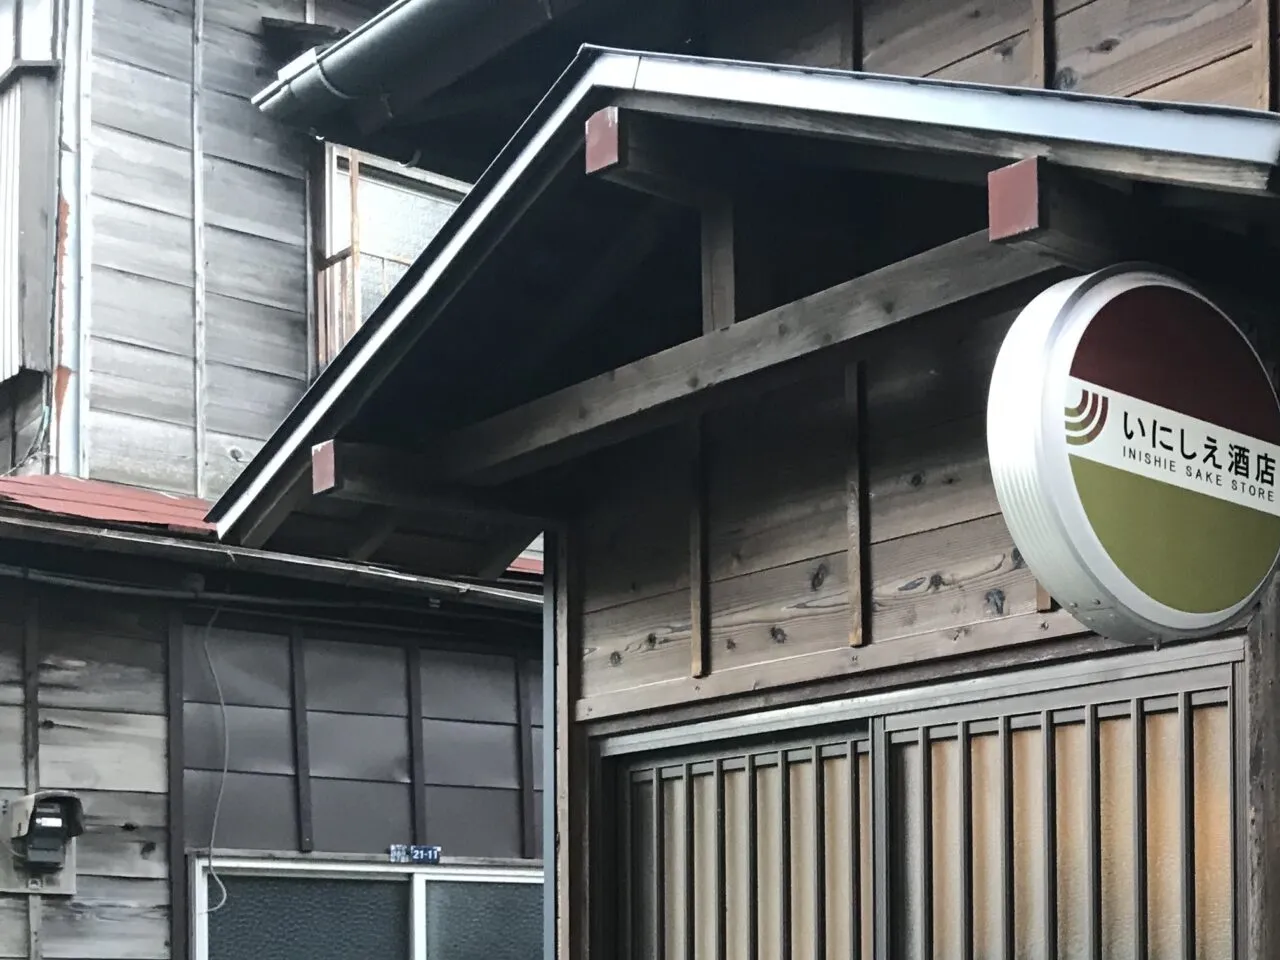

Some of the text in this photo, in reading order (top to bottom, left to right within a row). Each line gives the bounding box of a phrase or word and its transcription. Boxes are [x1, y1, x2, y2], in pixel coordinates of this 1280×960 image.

[1123, 411, 1276, 487] いにしえ酒店
[1123, 446, 1274, 502] INISHIE SAKE STORE
[412, 849, 438, 860] 21-11
